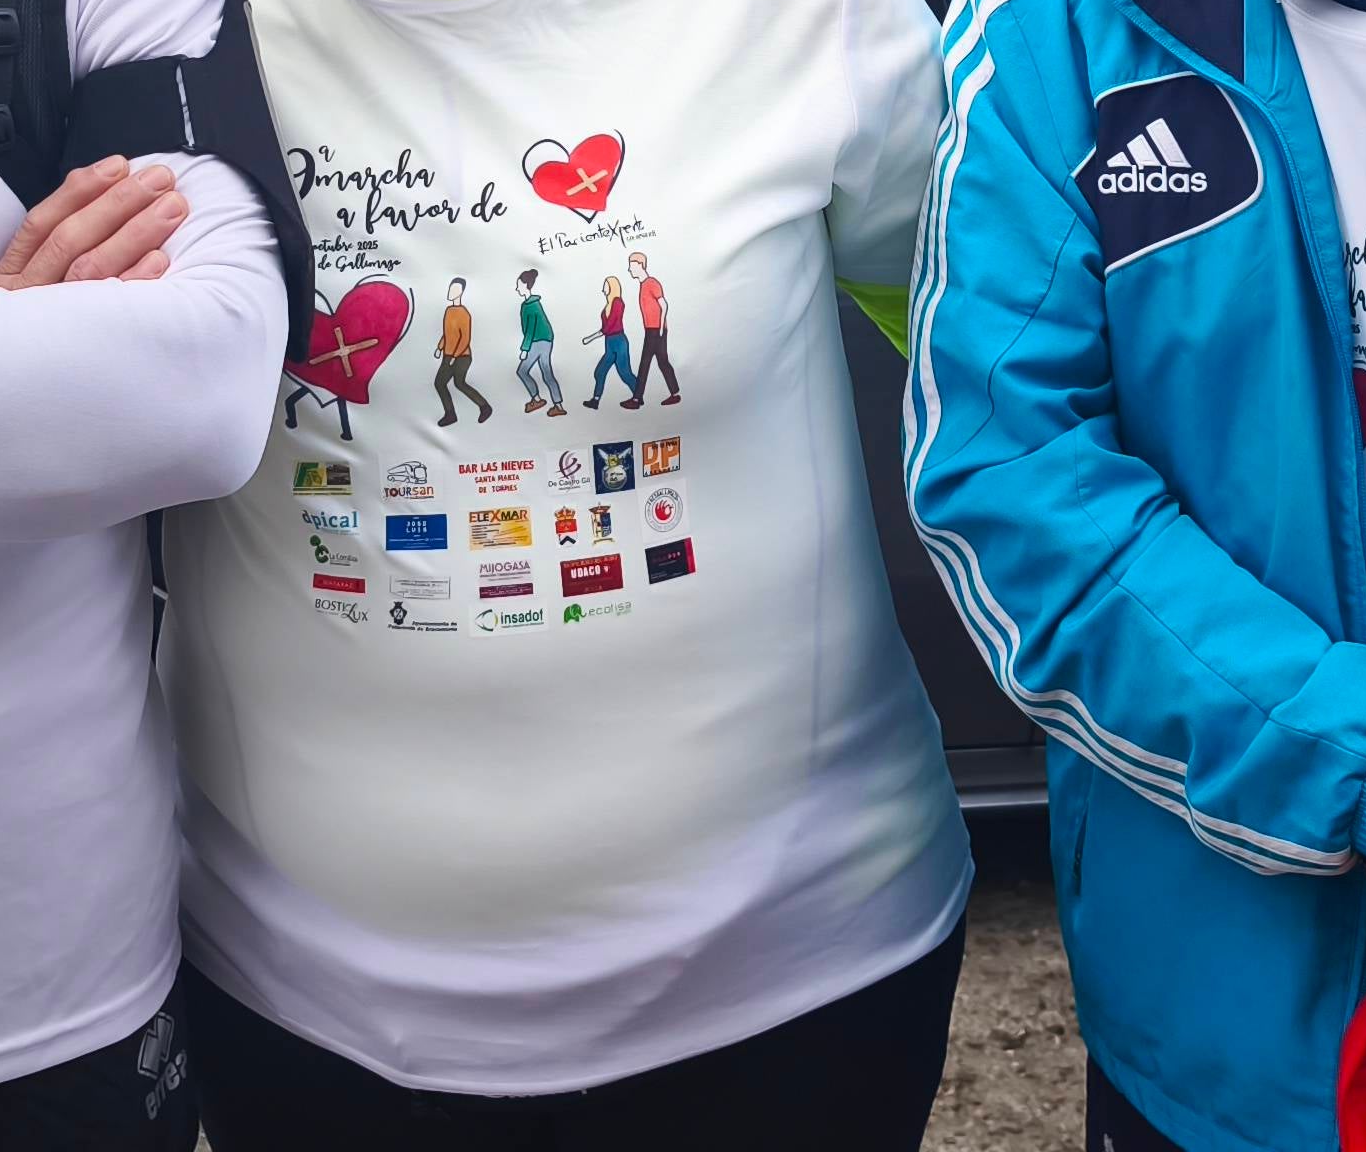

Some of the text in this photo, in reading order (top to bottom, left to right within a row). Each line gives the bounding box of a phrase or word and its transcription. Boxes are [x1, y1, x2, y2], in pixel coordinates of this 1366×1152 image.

[315, 149, 436, 192] marcha
[1097, 164, 1209, 195] adidas
[336, 181, 508, 235] a favor de
[357, 239, 379, 251] 2025
[317, 254, 333, 271] de
[458, 460, 534, 474] BAR LAS NIEVES
[475, 476, 496, 484] SANTA
[479, 560, 531, 574] MIJOGASA
